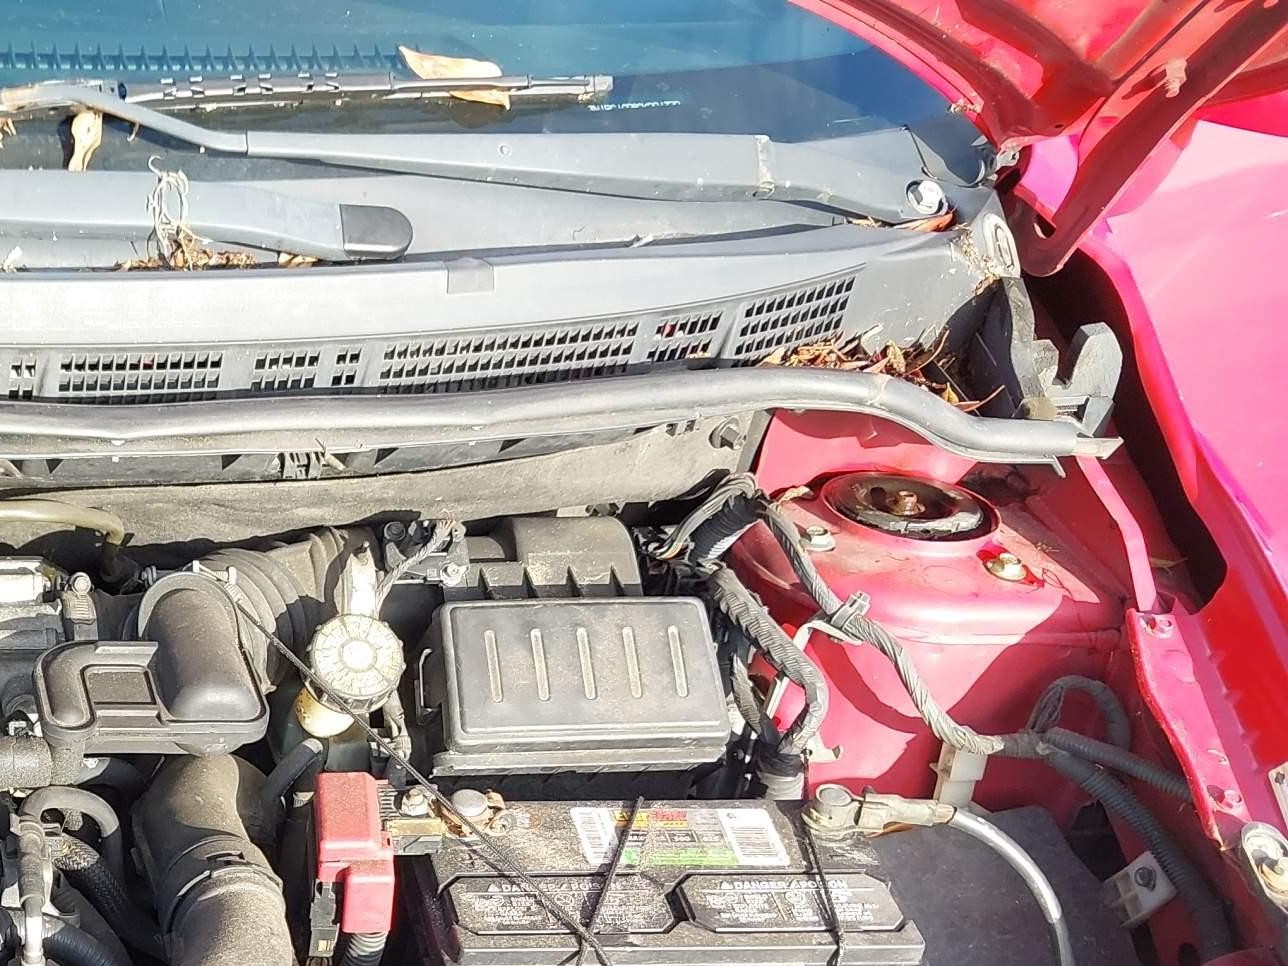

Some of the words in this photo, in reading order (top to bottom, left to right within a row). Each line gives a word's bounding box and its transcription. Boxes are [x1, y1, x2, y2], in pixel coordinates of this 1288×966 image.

[501, 882, 557, 892] DANGER
[570, 881, 623, 891] POISN
[734, 881, 787, 890] DANGER
[800, 879, 848, 889] POON
